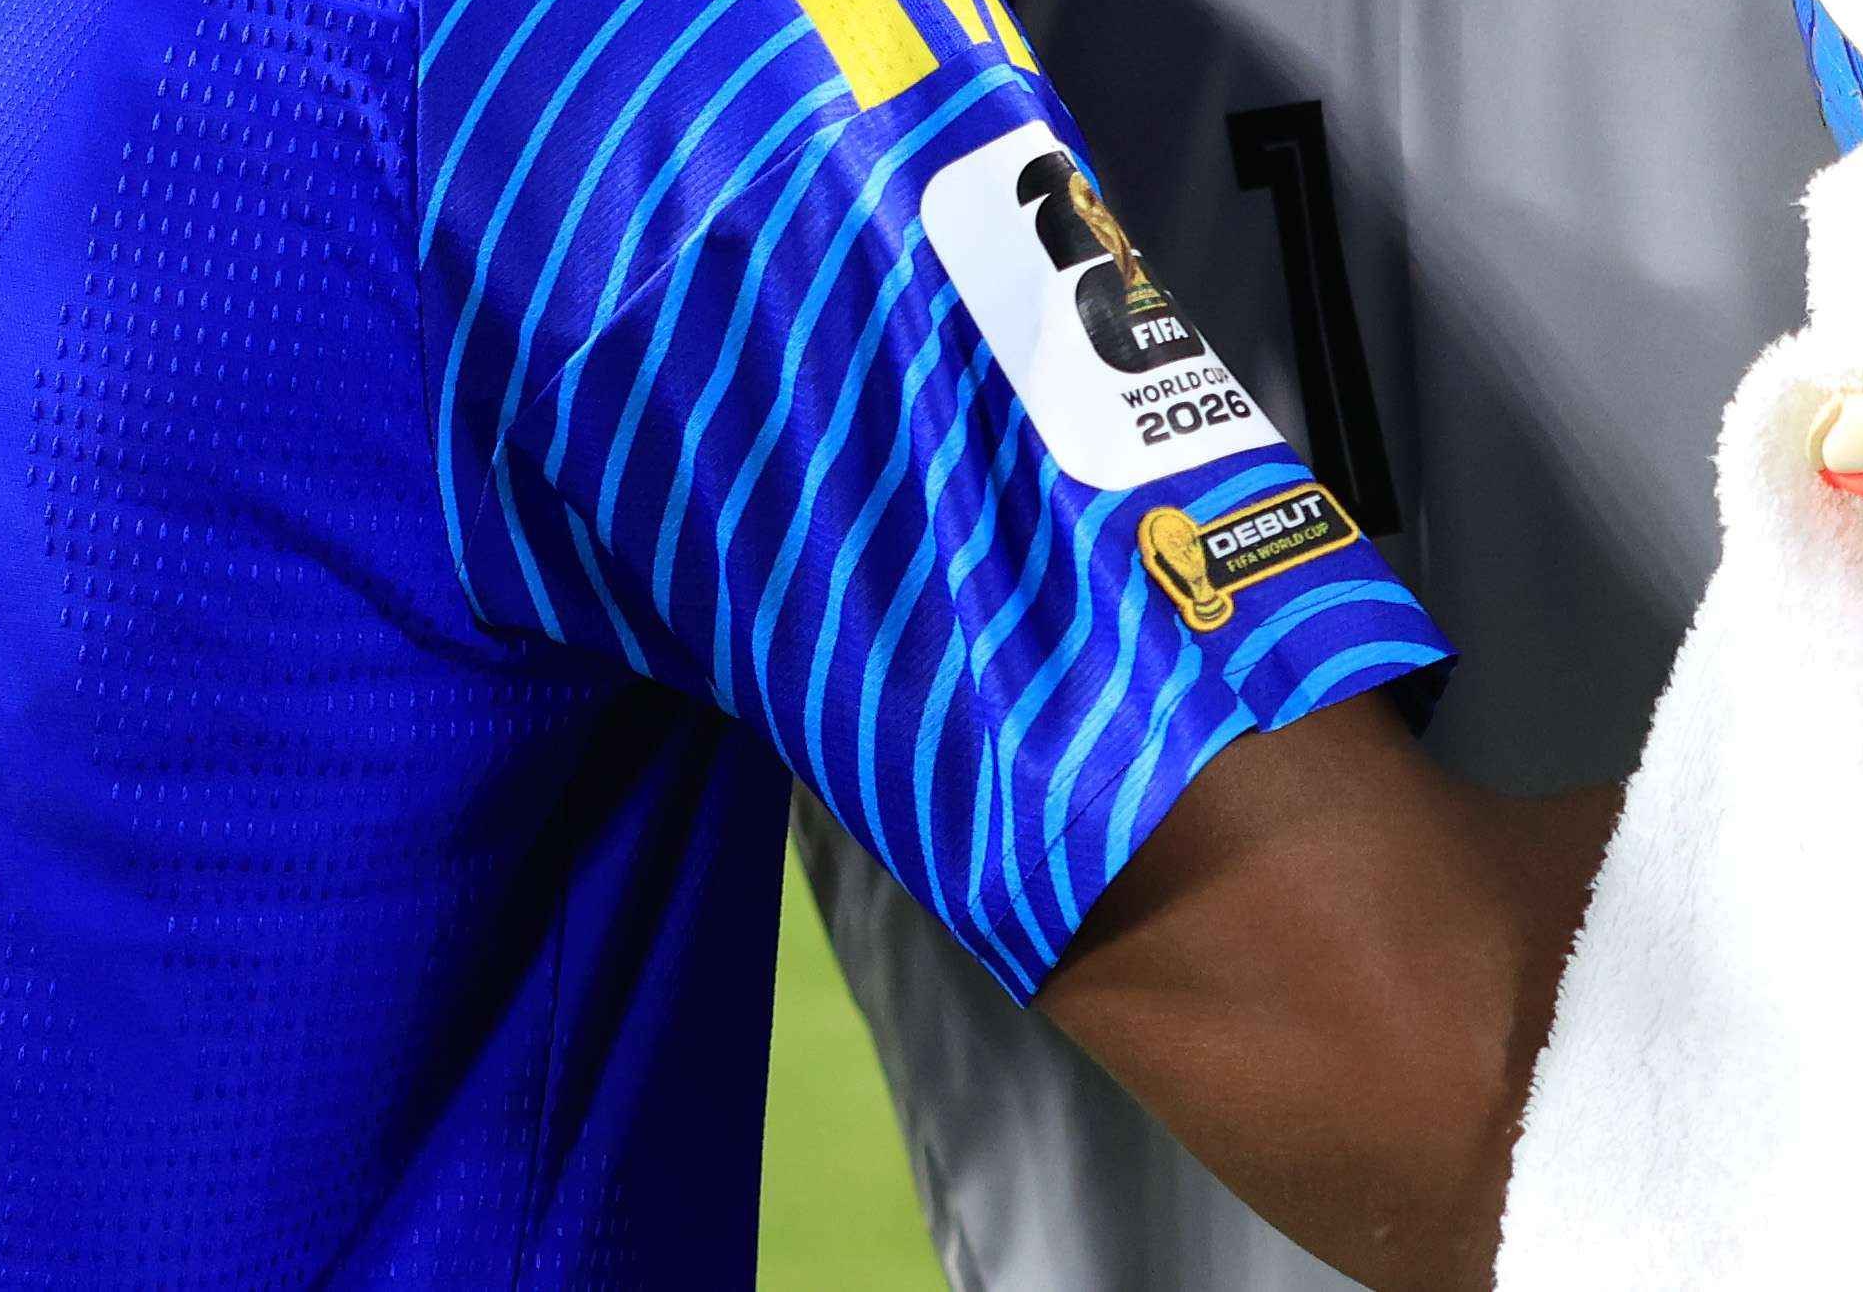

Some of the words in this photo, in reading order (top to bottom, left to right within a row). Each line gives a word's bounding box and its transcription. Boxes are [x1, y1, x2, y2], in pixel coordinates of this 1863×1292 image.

[1130, 315, 1189, 350] FIFA
[1225, 99, 1405, 535] 1
[1120, 370, 1203, 410] WORLD
[1135, 388, 1252, 447] 2026
[1206, 494, 1323, 560] DEBUT
[1225, 551, 1259, 573] FIFA
[1256, 532, 1305, 560] WORLD
[1304, 520, 1330, 540] CUP
